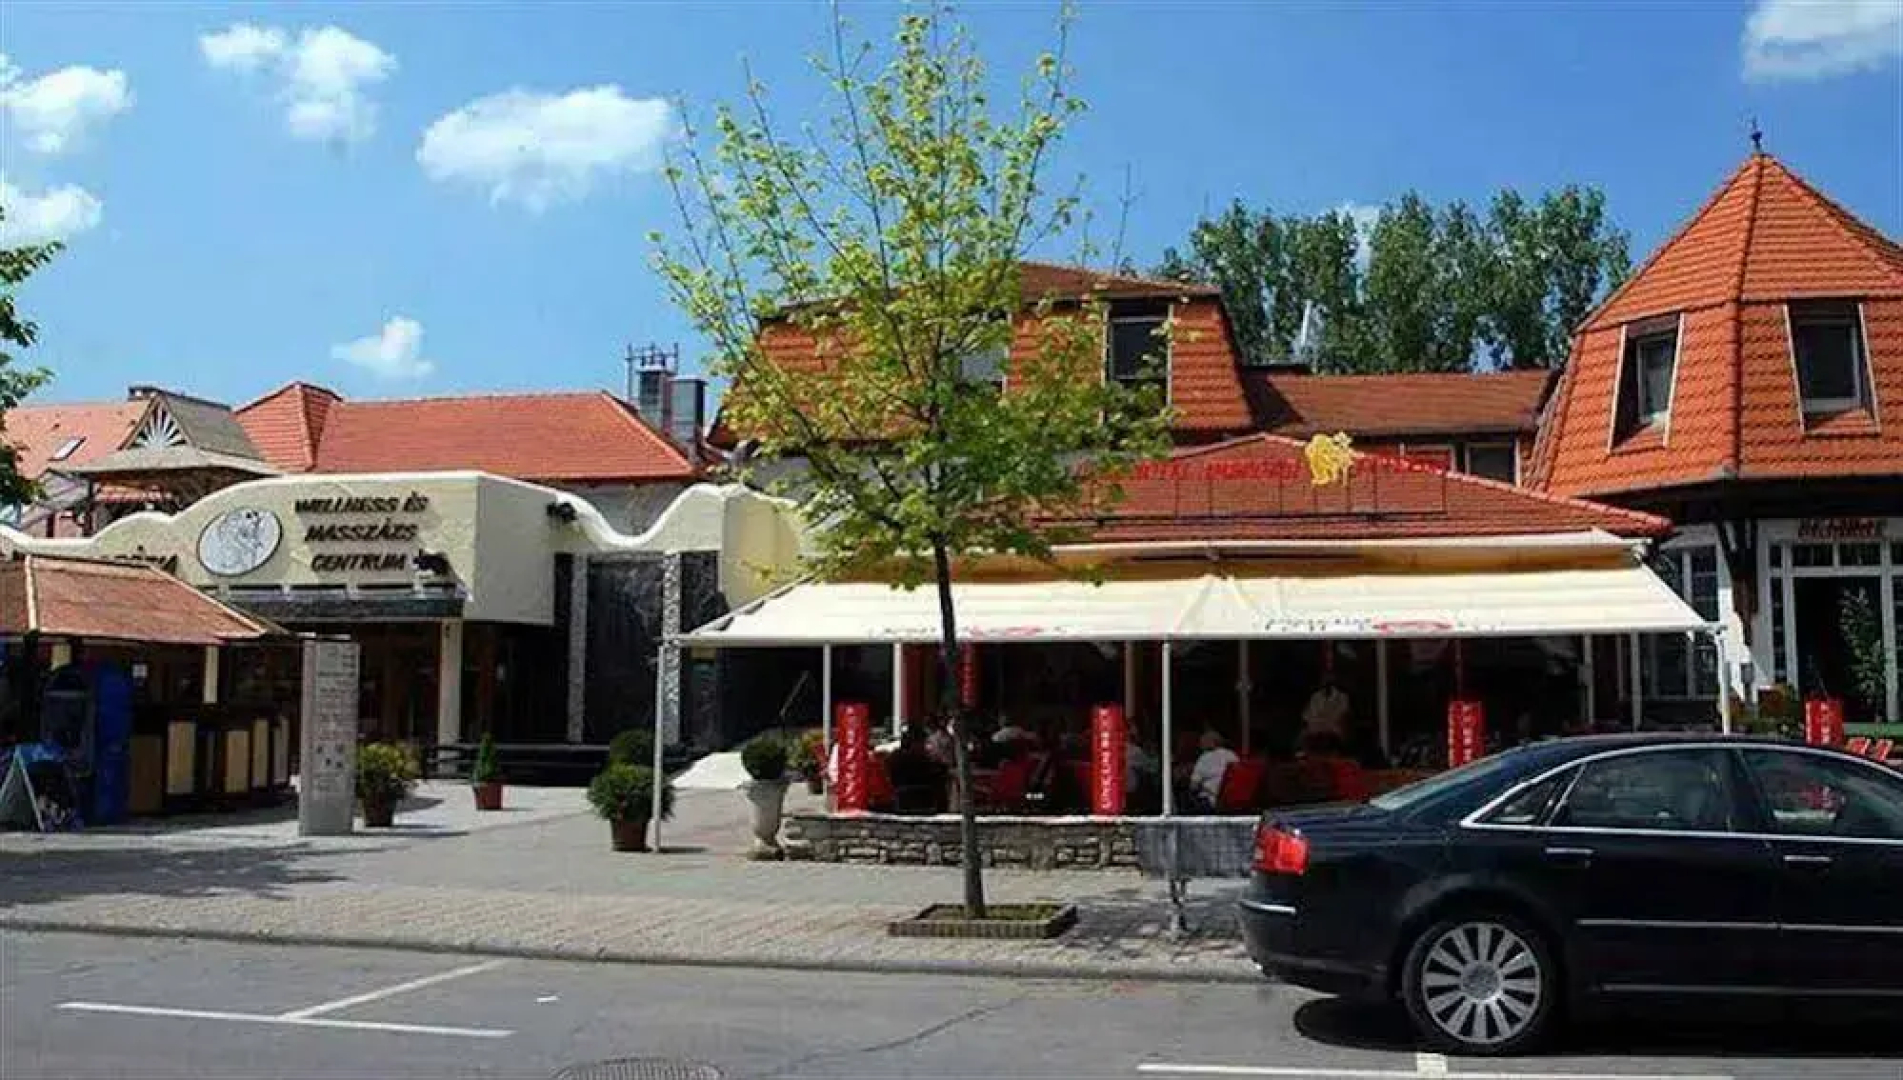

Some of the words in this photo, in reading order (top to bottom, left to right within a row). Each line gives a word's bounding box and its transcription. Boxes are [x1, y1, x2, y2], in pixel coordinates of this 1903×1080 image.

[295, 497, 399, 513] WELLNESS
[403, 490, 429, 512] ÉS
[305, 517, 418, 541] MASSZÁZS
[311, 553, 406, 571] CENTRUM
